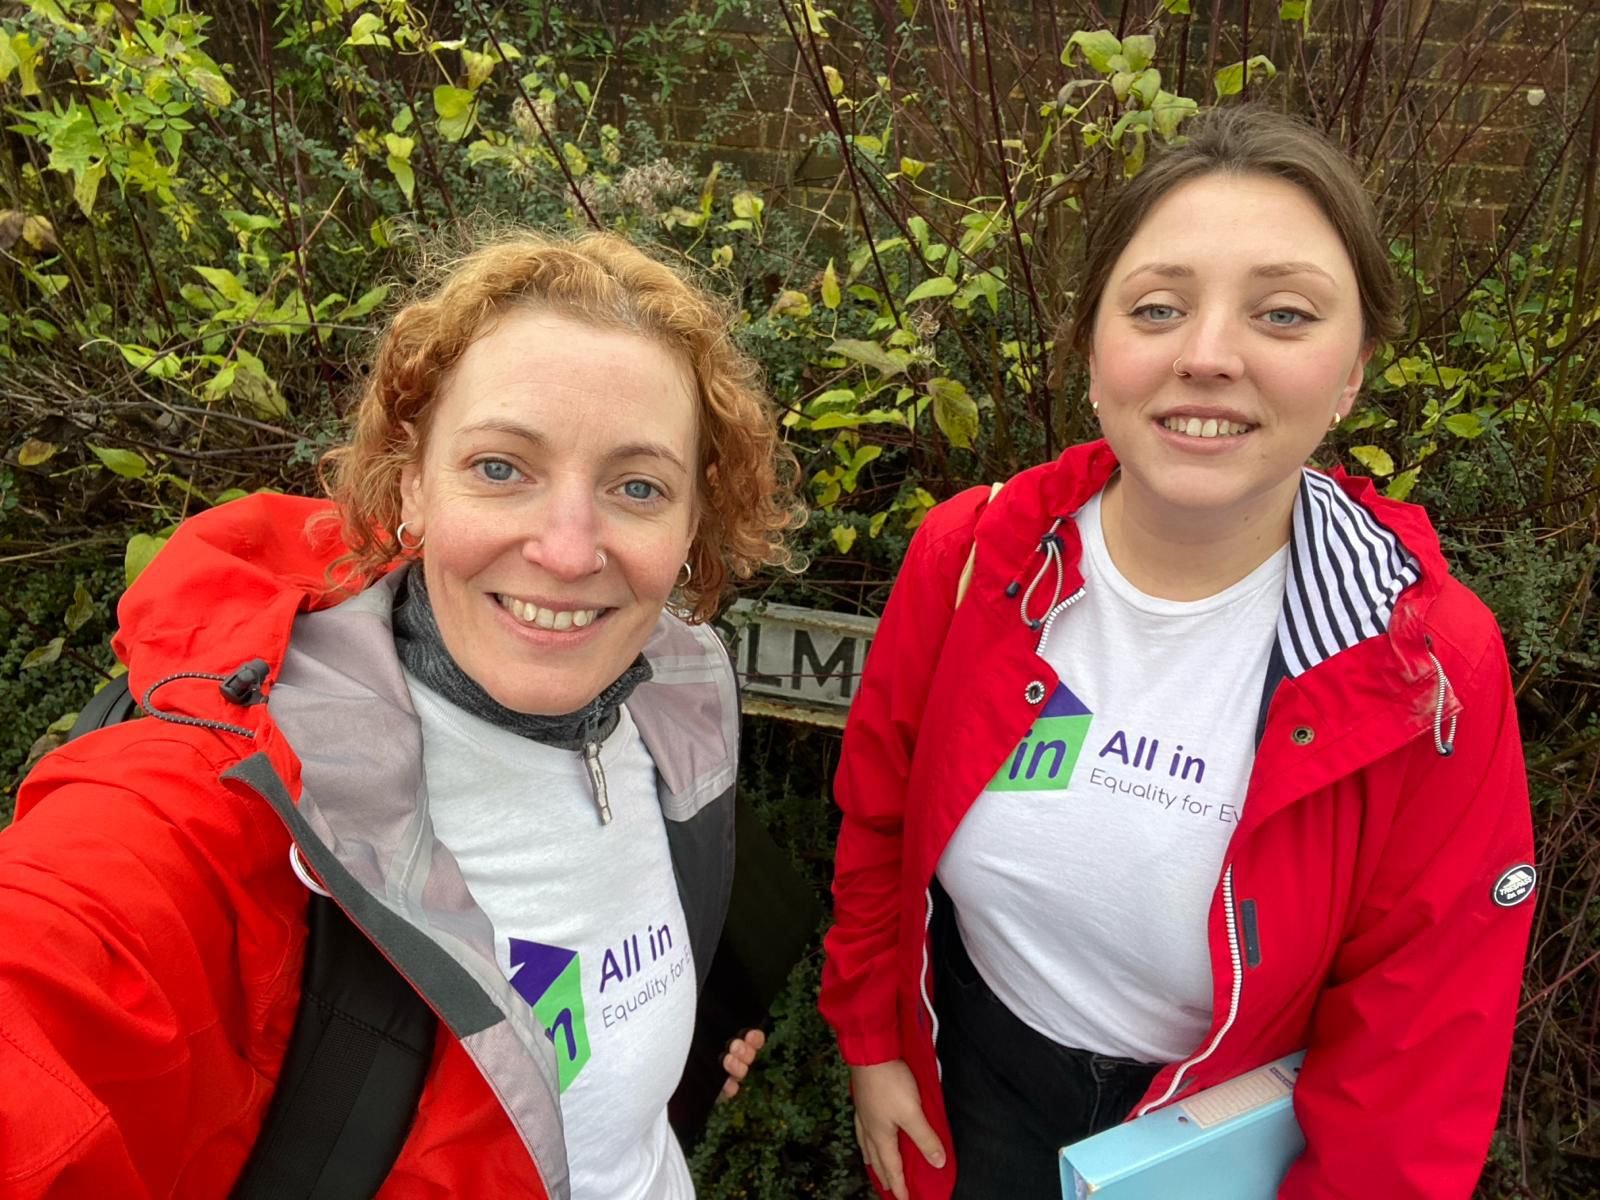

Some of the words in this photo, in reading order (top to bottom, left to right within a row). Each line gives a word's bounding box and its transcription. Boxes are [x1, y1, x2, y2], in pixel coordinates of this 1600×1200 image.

[717, 620, 873, 698] LM
[1008, 728, 1067, 781] in
[1099, 730, 1159, 771] All
[1169, 745, 1206, 784] in
[1090, 767, 1177, 810] Equality
[1181, 794, 1213, 817] for
[599, 934, 641, 994] All
[648, 924, 673, 962] in
[602, 975, 668, 1029] Equality
[670, 957, 685, 983] for
